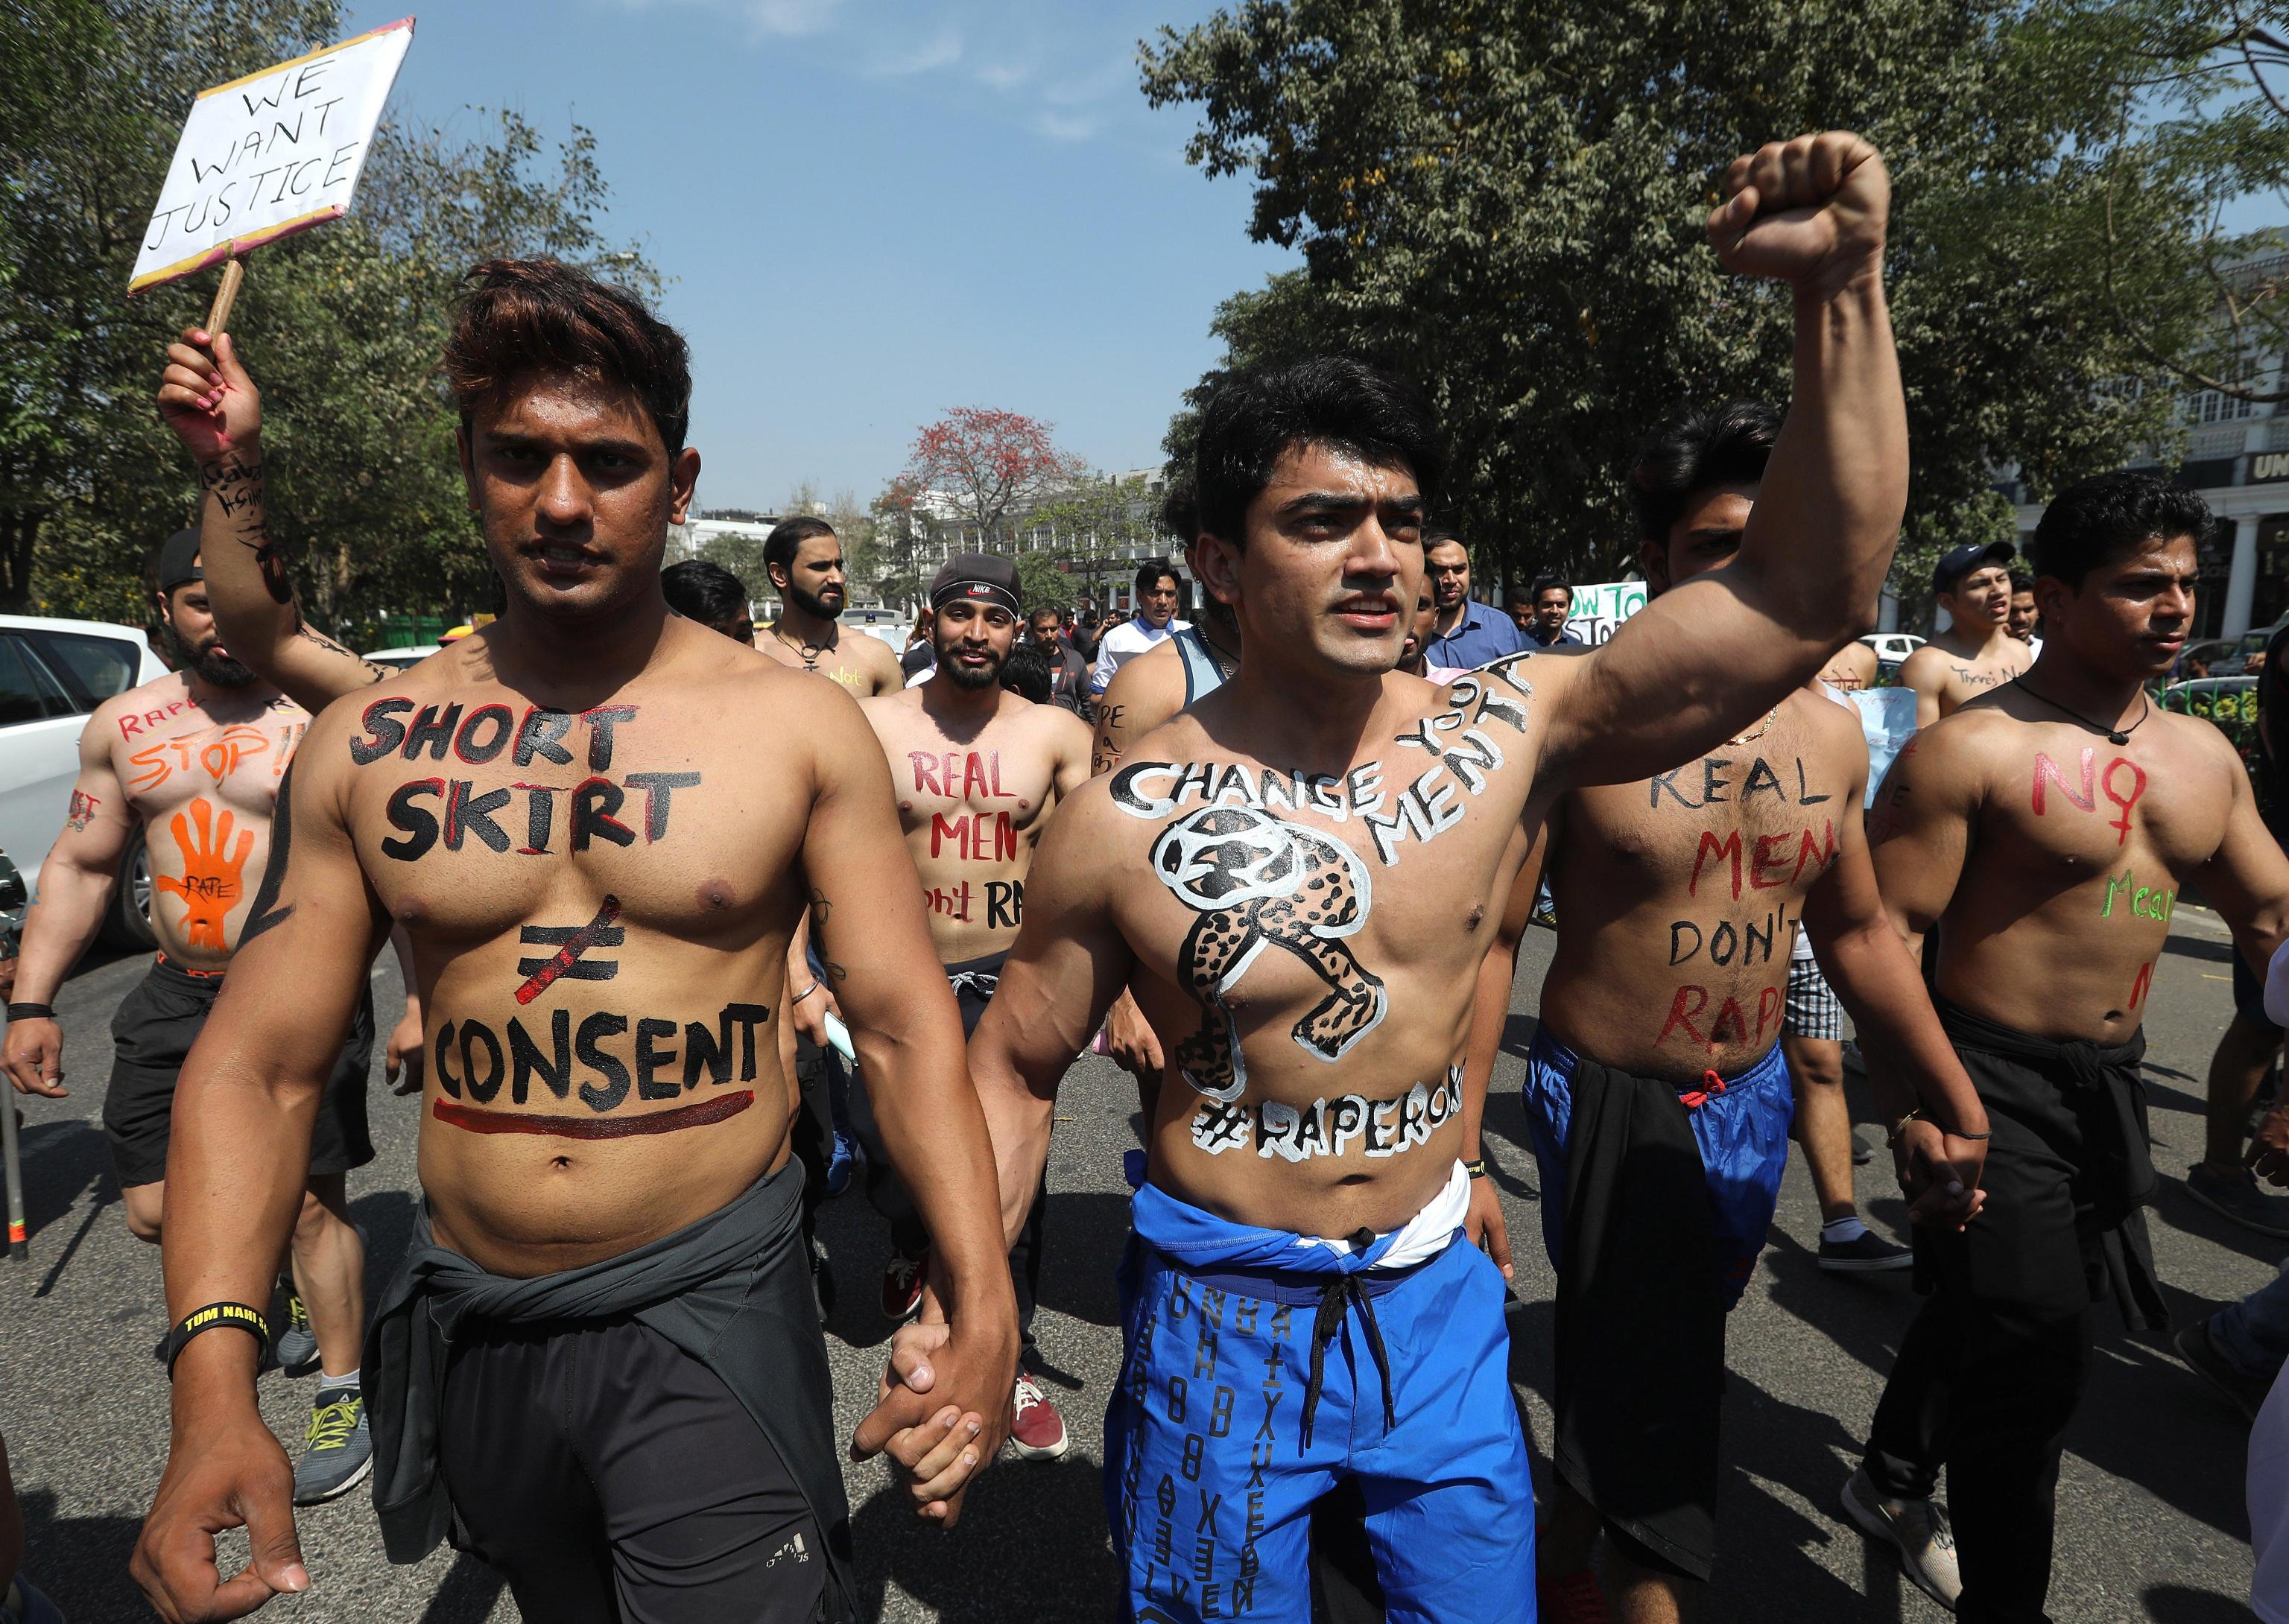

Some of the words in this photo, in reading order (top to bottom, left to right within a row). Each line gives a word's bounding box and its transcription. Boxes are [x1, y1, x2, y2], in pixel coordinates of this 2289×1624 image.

[243, 60, 335, 116] WE
[191, 98, 343, 184] WANT
[148, 142, 359, 250] JUSTICE
[972, 584, 990, 593] NIKE
[1603, 585, 1645, 619] TO
[829, 666, 862, 686] Not
[349, 697, 642, 773] SHORT
[908, 750, 1018, 804] REAL
[1109, 761, 1387, 822] CHANGE
[1650, 757, 1833, 808] REAL
[381, 772, 702, 862] SKIRT
[930, 811, 1019, 862] MEN
[1688, 819, 1834, 901] MEN
[178, 875, 235, 904] RAPE
[1668, 902, 1801, 968] DON'T
[434, 1003, 770, 1113] CONSENT
[185, 1307, 218, 1333] TUM
[223, 1306, 257, 1324] NAHI
